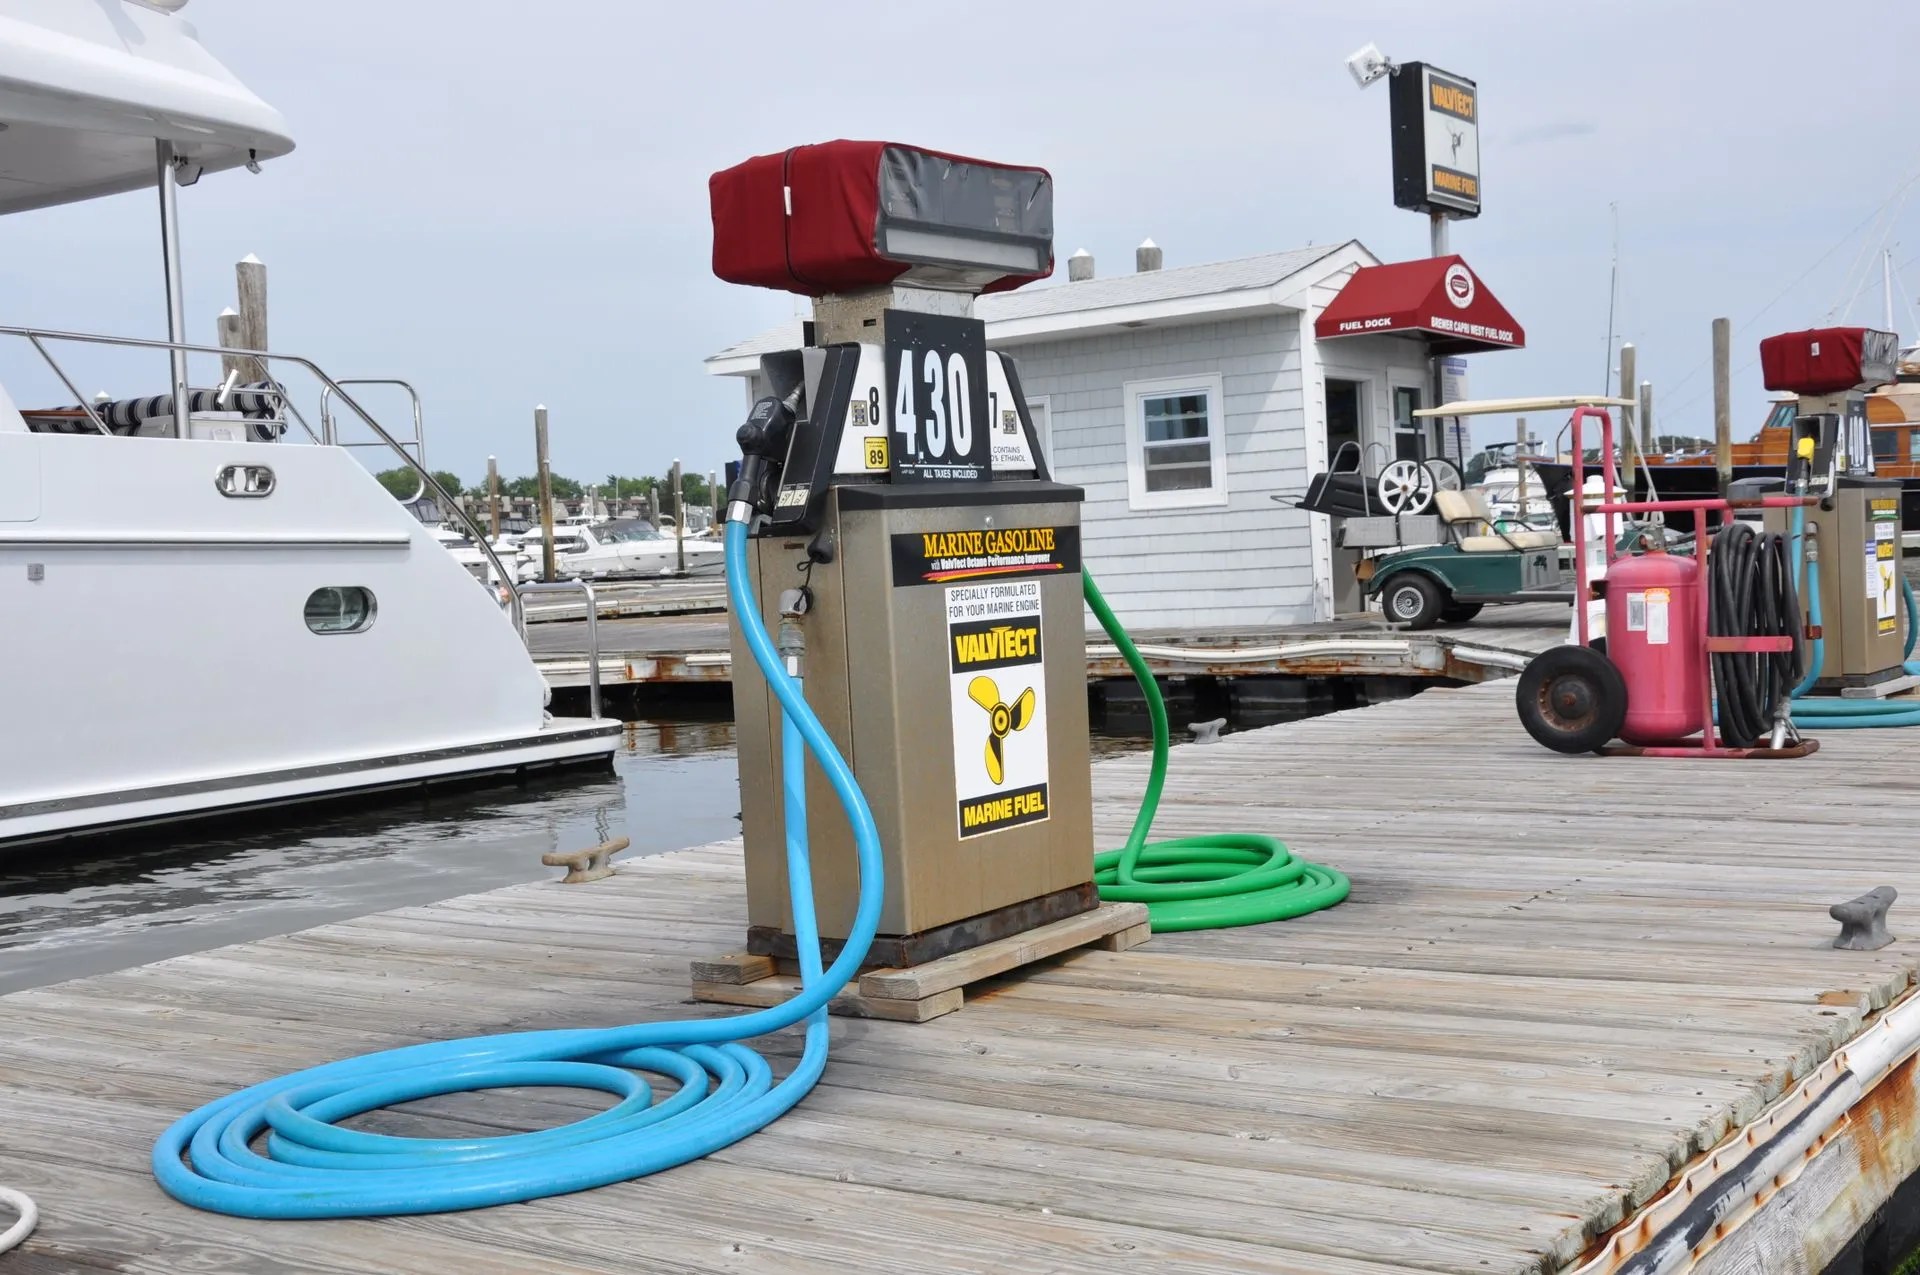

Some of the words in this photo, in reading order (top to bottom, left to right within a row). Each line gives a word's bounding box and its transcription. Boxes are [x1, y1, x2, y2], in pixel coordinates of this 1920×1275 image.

[1431, 83, 1474, 118] VALVTECT
[1434, 170, 1461, 192] MARINE
[1461, 176, 1477, 196] FUEL
[1340, 321, 1363, 331] FUEL
[1364, 317, 1391, 328] DOCK
[1431, 316, 1453, 331] BREWER
[1470, 324, 1485, 337] WEST
[1485, 327, 1498, 339] FUEL
[1498, 330, 1513, 342] DOCK
[869, 449, 884, 465] 89
[992, 446, 1021, 454] CONTAINS
[1000, 454, 1026, 463] ETHANOL
[923, 468, 933, 479] ALL
[933, 469, 951, 479] TAXES
[952, 469, 978, 479] INCLUDED
[923, 531, 983, 558] MARINE
[985, 528, 1055, 554] GASOLINE
[967, 556, 988, 568] Octane
[987, 554, 1025, 567] Performance
[1025, 553, 1051, 565] Improver
[950, 588, 988, 602] SPECIALLY
[990, 584, 1037, 598] FORMULATED
[949, 605, 964, 618] FOR
[965, 603, 985, 616] YOUR
[986, 601, 1015, 615] MARINE
[1015, 599, 1040, 612] ENGINE
[955, 625, 1037, 664] VALVTECT
[963, 797, 1013, 828] MARINE
[1014, 791, 1045, 816] FUEL
